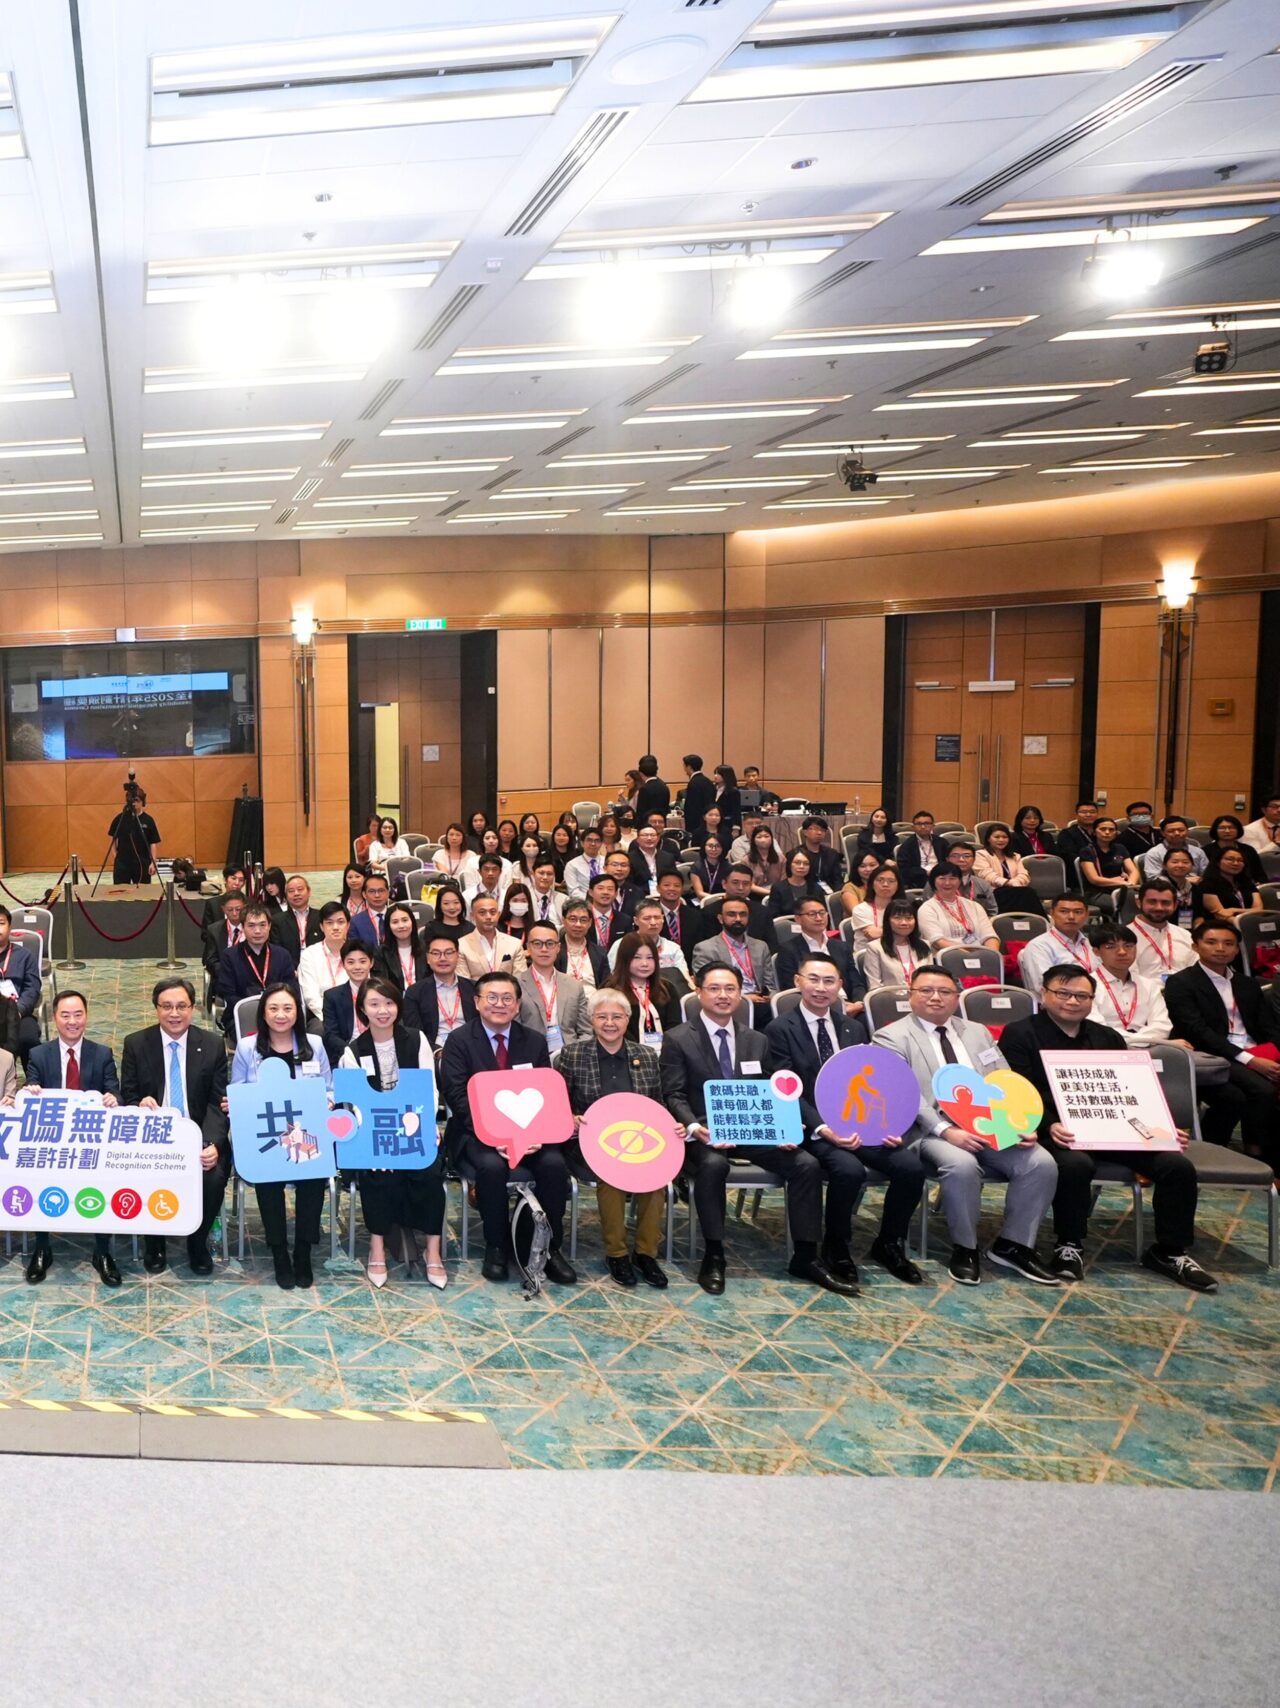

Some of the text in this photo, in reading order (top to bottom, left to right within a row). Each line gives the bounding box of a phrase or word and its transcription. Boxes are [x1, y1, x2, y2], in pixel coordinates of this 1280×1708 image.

[1055, 1068, 1117, 1080] 讓科技成就
[711, 1099, 774, 1112] 讓每個人都
[1063, 1095, 1139, 1107] 支持數碼共融
[713, 1113, 775, 1126] 能輕鬆享受
[256, 1100, 307, 1154] 共
[370, 1104, 425, 1157] 融
[15, 1147, 101, 1170] 嘉許計劃
[106, 1151, 186, 1162] Digital Accessibility
[104, 1161, 187, 1171] Recognition Scheme
